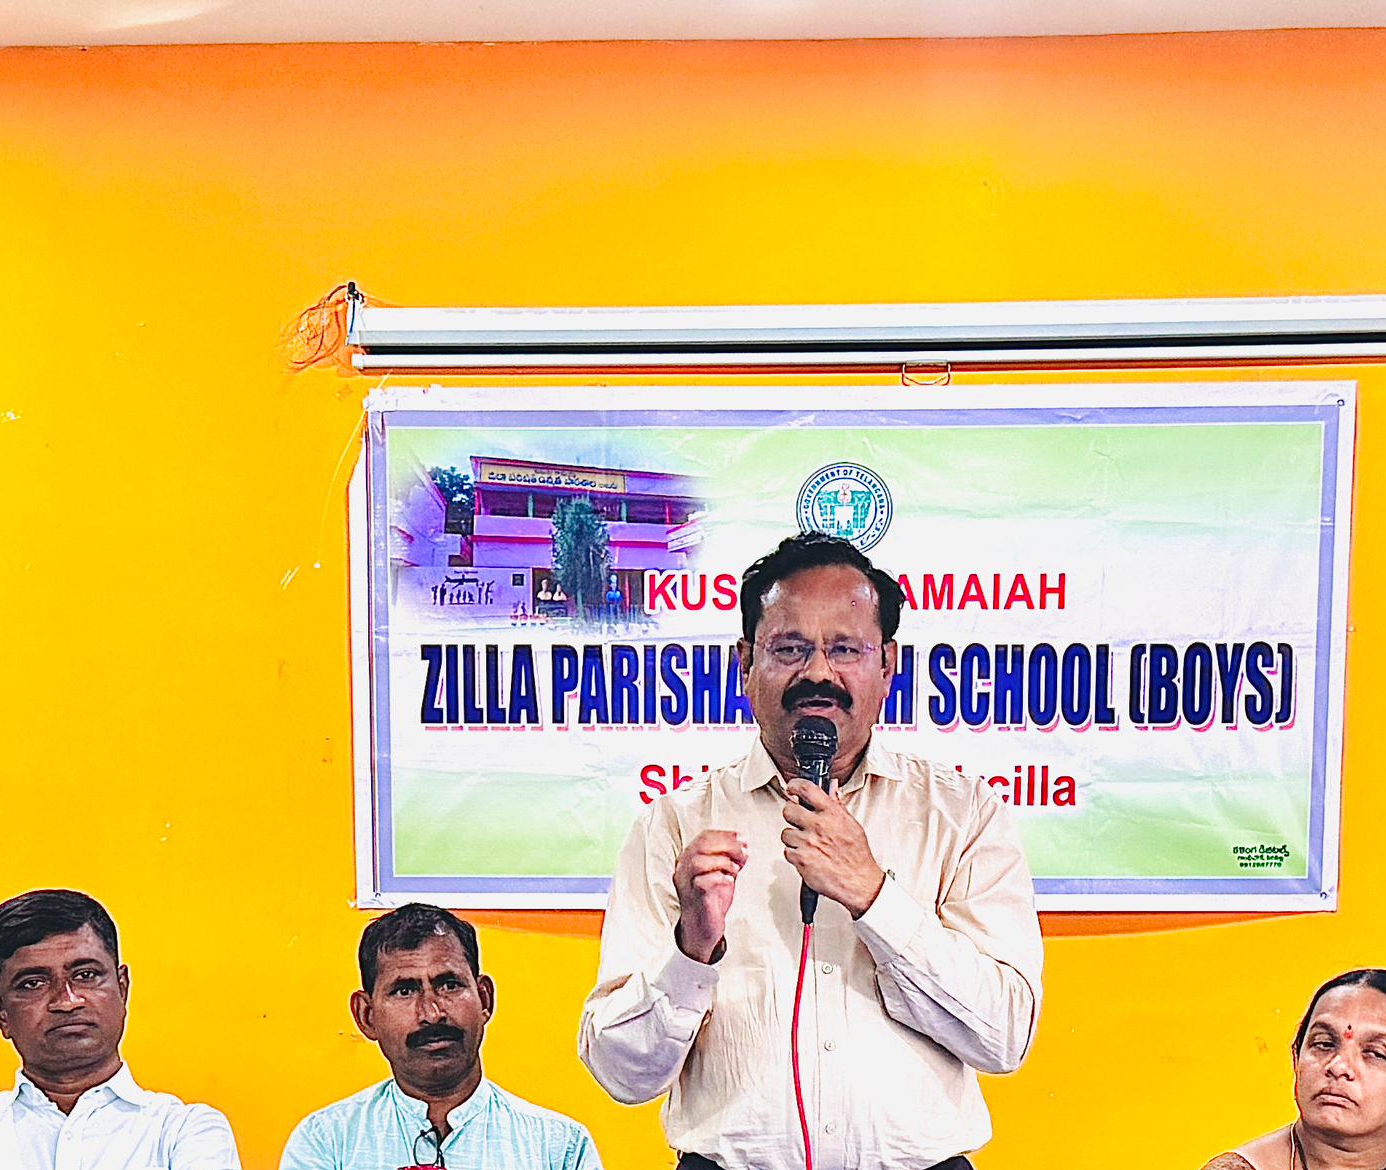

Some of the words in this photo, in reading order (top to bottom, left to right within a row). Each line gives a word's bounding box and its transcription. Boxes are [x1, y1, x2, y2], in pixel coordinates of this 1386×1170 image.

[648, 573, 739, 611] KUS
[897, 573, 1066, 611] AMAIAH
[420, 643, 541, 725] ZILLA
[551, 642, 755, 725] PARISHA
[928, 642, 1116, 725] SCHOOL
[1129, 642, 1293, 725] (BOYS)
